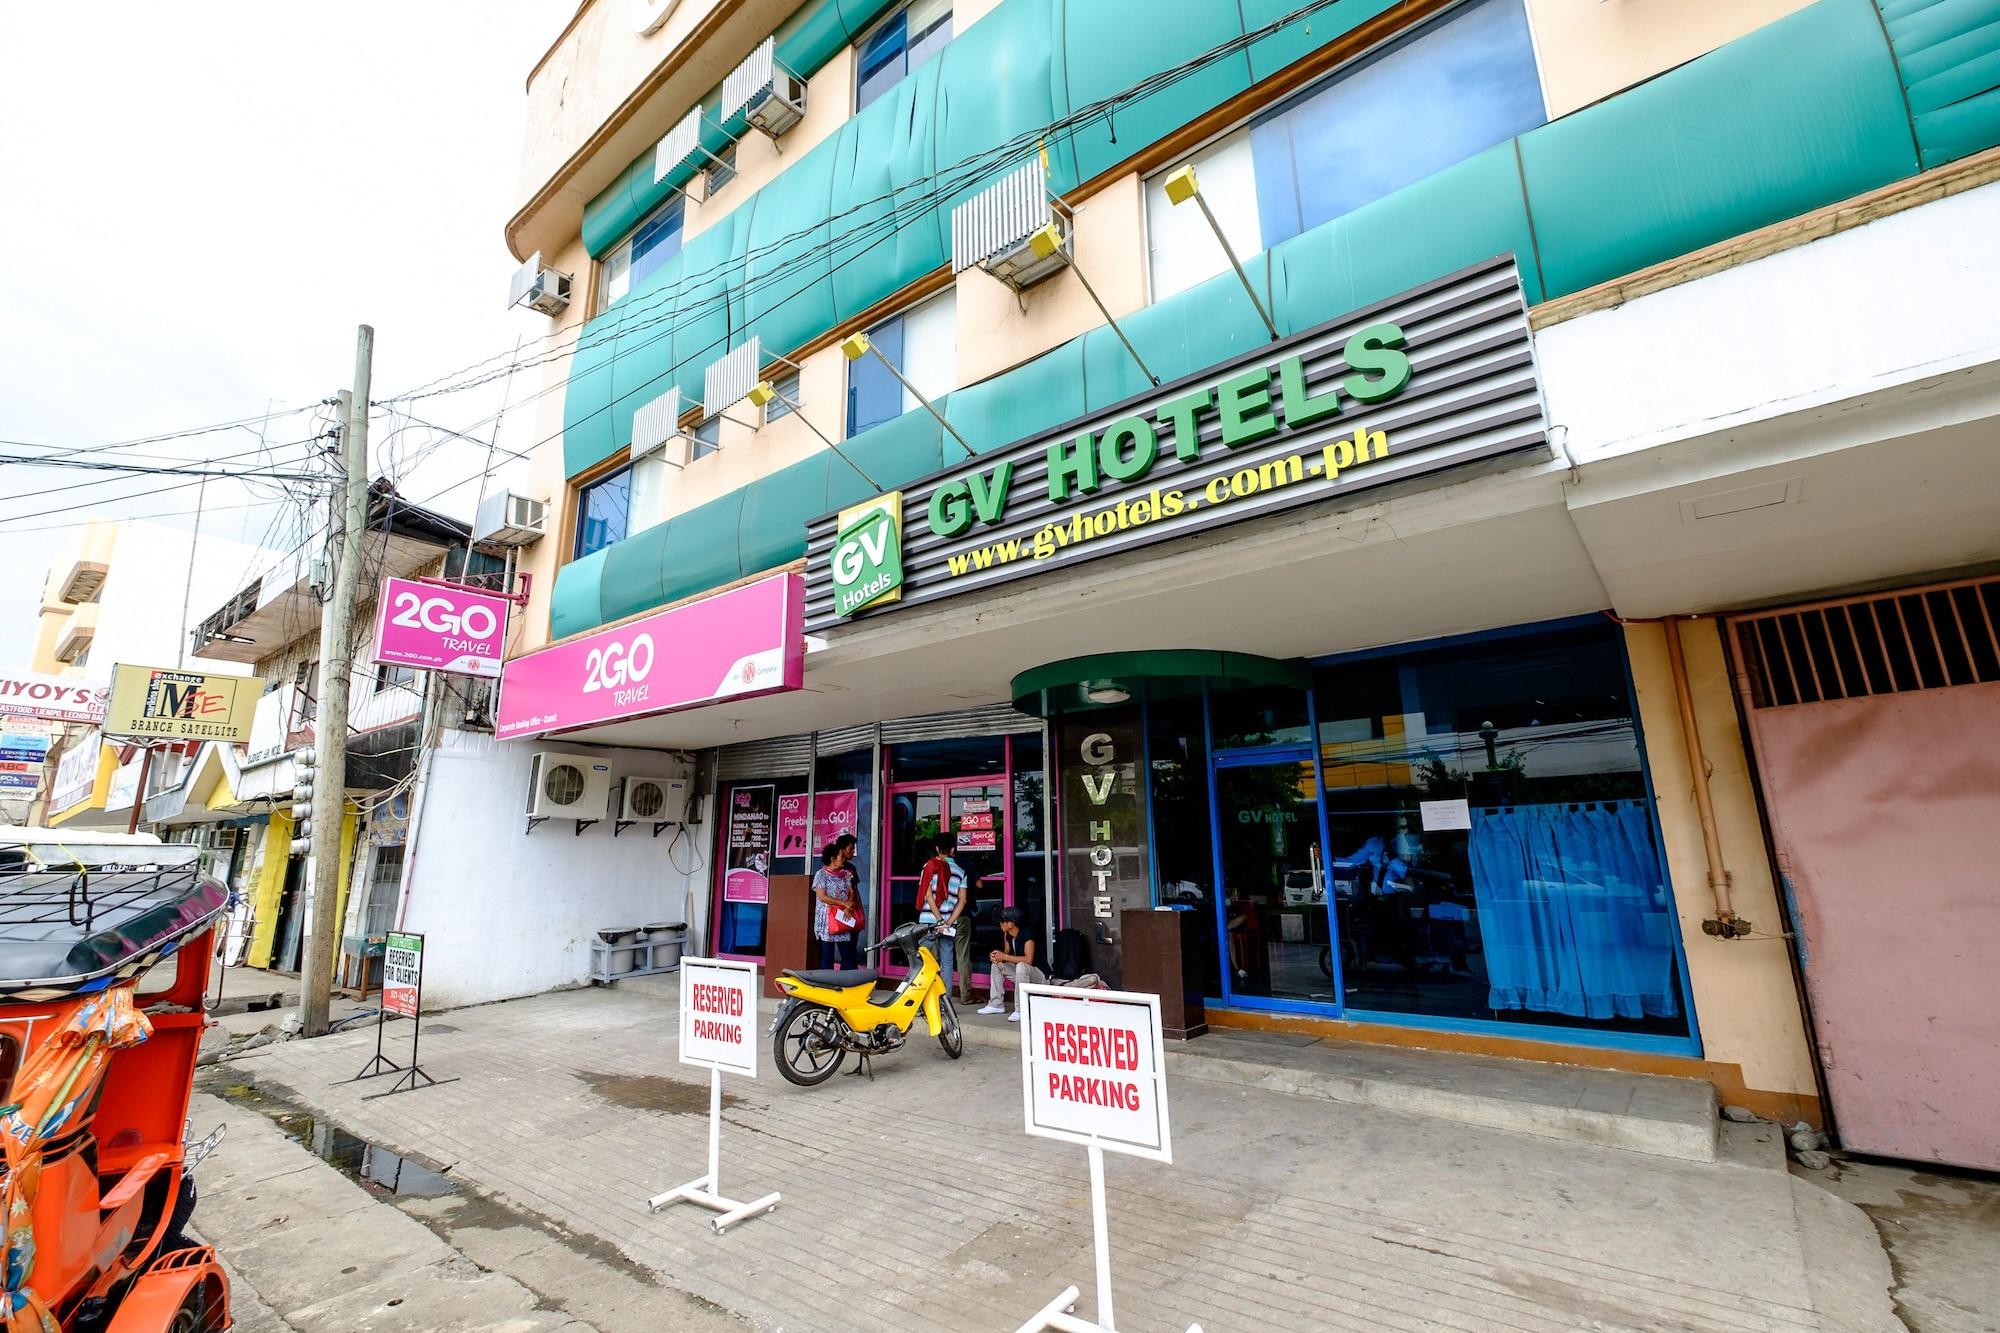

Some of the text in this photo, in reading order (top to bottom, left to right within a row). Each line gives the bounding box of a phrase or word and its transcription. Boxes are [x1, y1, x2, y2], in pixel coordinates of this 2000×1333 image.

[927, 322, 1413, 538] GV HOTELS
[947, 427, 1389, 577] www.gvhotels.com.ph
[832, 519, 890, 586] GV
[842, 572, 892, 611] Hotels
[392, 592, 497, 640] 2GO
[384, 650, 443, 662] www.2GO.com.ph
[442, 637, 491, 655] TRAVEL
[583, 633, 655, 693] 2GO
[154, 672, 202, 684] exchange
[0, 680, 91, 704] IYOY'S
[613, 687, 649, 707] TRAVEL
[130, 719, 239, 737] BRANCH SATELLITE
[781, 799, 799, 810] 2GO
[829, 811, 849, 824] GO!
[962, 815, 979, 825] 2GO
[1238, 810, 1298, 823] GV HOTEL
[389, 949, 416, 968] RESERVED
[385, 965, 418, 987] FOR CLIENTS
[692, 983, 743, 1017] RESERVED
[693, 1018, 742, 1044] PARKING
[1043, 1021, 1139, 1071] RESERVED
[1048, 1072, 1140, 1112] PARKING
